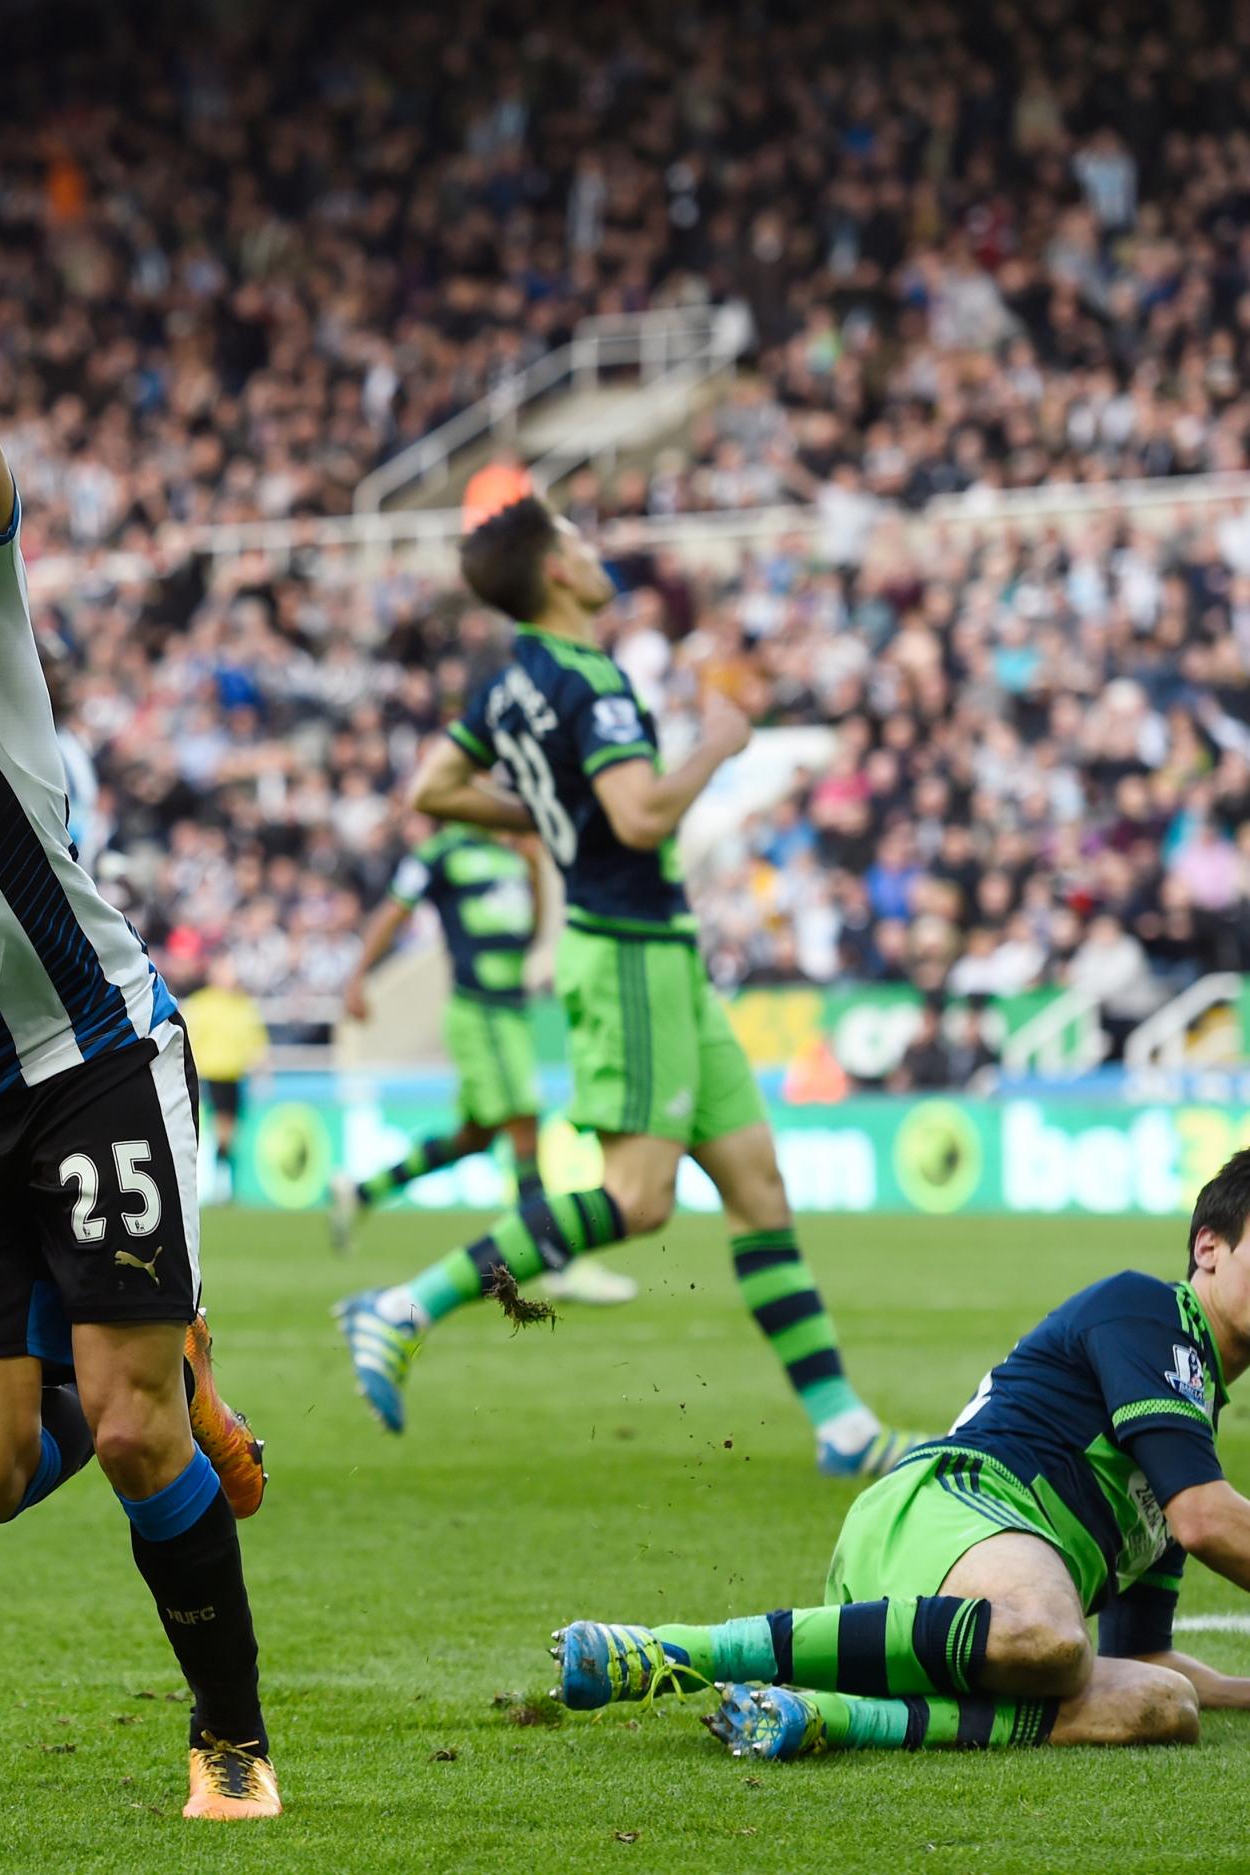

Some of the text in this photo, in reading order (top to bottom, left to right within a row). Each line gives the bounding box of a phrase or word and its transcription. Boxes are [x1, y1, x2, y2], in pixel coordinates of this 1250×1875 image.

[58, 1140, 162, 1243] 25
[1001, 1100, 1250, 1214] bet3
[165, 1605, 216, 1625] NUFC
